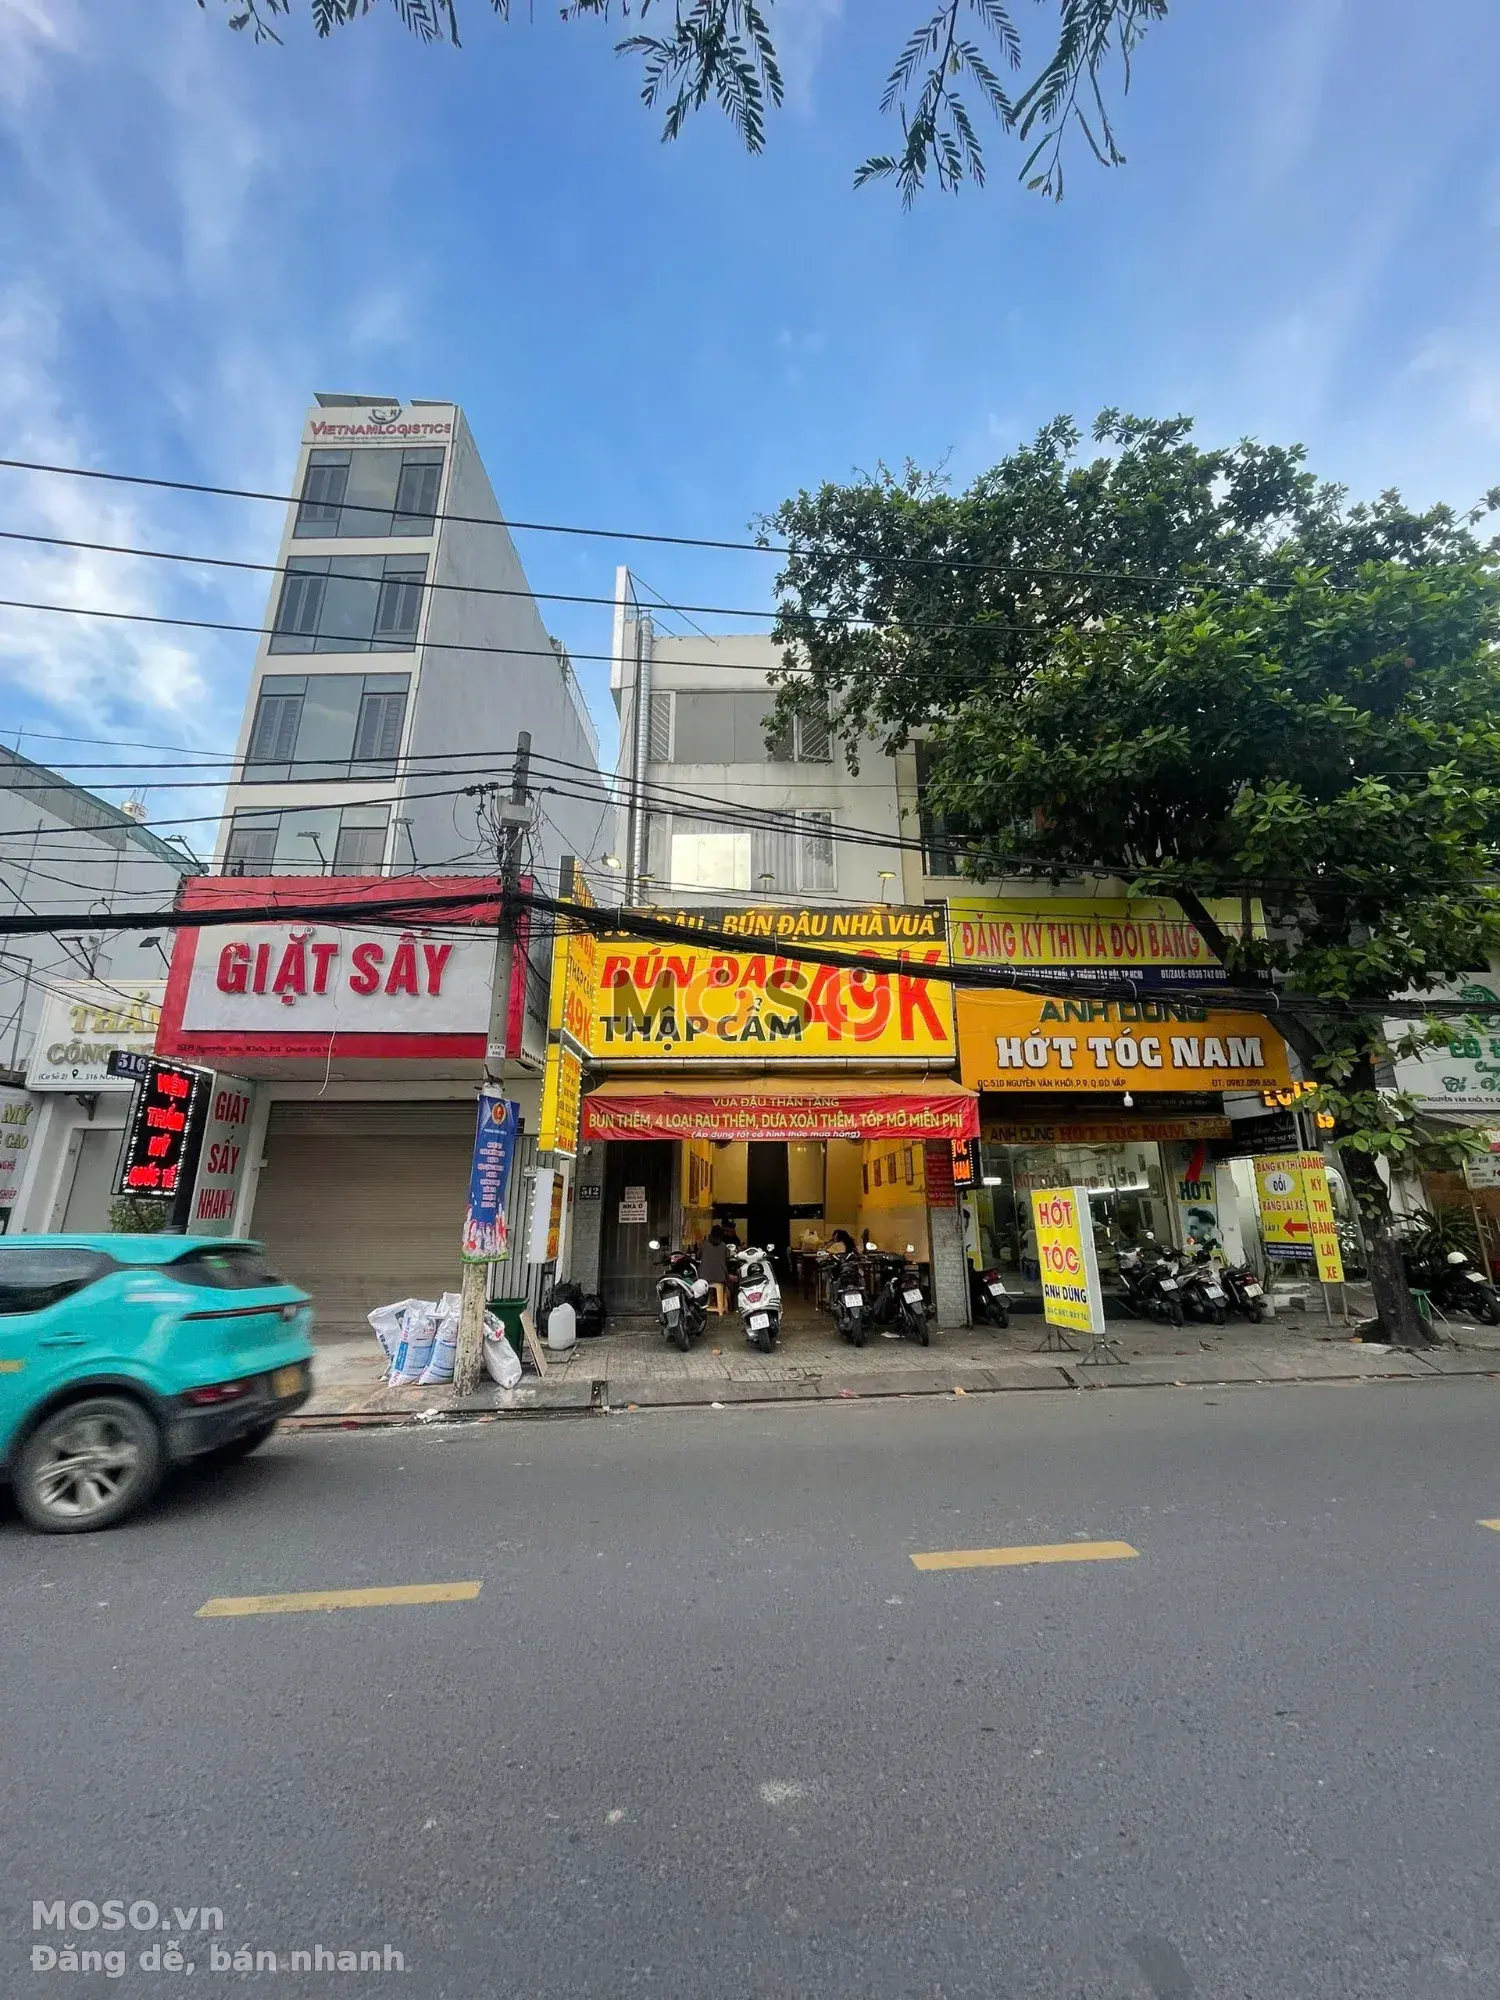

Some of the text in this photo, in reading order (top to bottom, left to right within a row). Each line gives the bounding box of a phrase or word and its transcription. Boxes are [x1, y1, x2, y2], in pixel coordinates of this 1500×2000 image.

[310, 420, 451, 435] VIETNAMLOGISTICS
[722, 911, 772, 936] BÚN
[776, 910, 827, 940] ĐẬU
[832, 910, 884, 936] NHÀ
[962, 913, 1016, 958] ĐĂNG
[1047, 922, 1077, 958] THI
[216, 927, 455, 1006] GIẶT SẤY
[600, 948, 696, 990] BÚN
[804, 949, 947, 1042] 49K
[566, 989, 593, 1050] 49K
[600, 998, 803, 1051] THẬP CẨM
[996, 1027, 1265, 1069] HỚT TÓC NAM
[118, 1054, 147, 1072] 516
[1006, 1077, 1036, 1088] NGUYỄN
[215, 1089, 250, 1130] GIẶT
[713, 1097, 736, 1107] VUA
[589, 1106, 963, 1131] BÚN THÊM, 4 LOẠI RAU THÊM, DƯA XOÀI THÊM, TÓP MỠ MIỄN PHÍ
[711, 1131, 734, 1140] dụng
[207, 1134, 242, 1175] SẤY
[581, 1186, 599, 1196] 512
[1273, 1175, 1287, 1192] ĐỔI
[1038, 1196, 1073, 1228] HỚT
[1295, 1199, 1305, 1211] XE
[1312, 1199, 1328, 1213] THI
[1042, 1239, 1080, 1275] TÓC
[1320, 1241, 1336, 1257] LÁI
[1325, 1266, 1338, 1280] XE
[1044, 1285, 1061, 1299] ANH
